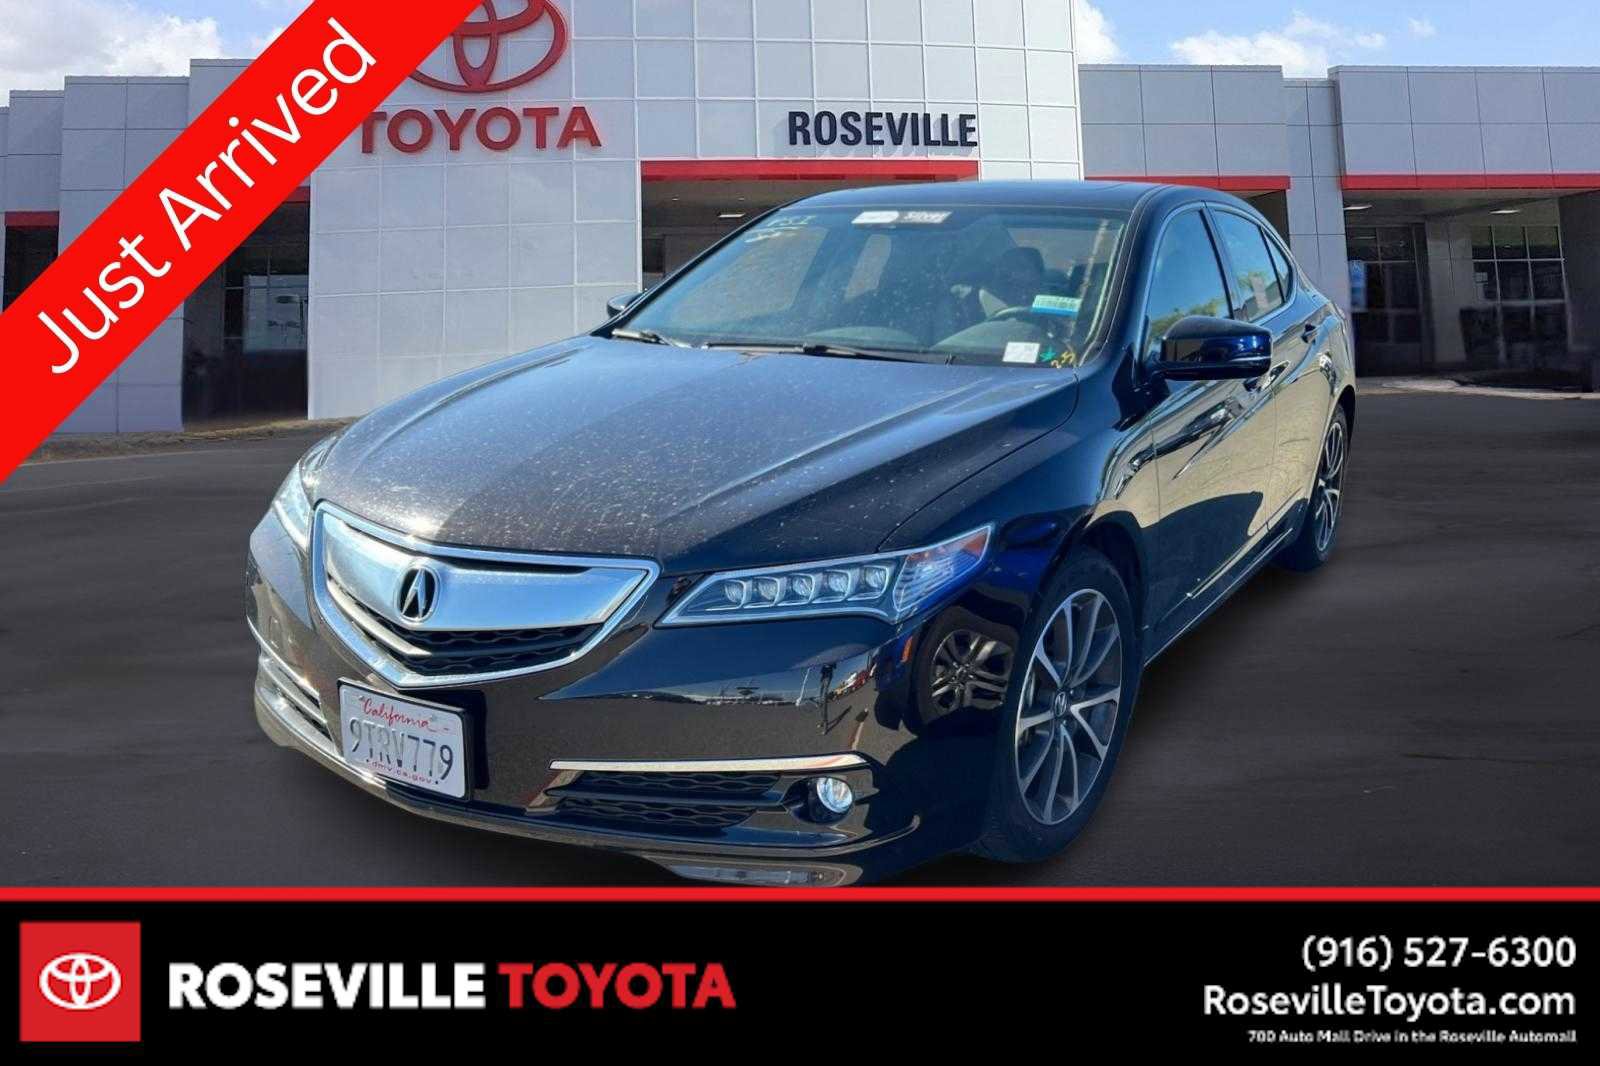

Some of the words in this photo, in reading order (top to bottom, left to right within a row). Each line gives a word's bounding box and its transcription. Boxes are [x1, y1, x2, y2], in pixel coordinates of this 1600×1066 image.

[360, 106, 602, 154] TOYOTA
[788, 111, 978, 147] ROSEVILLE
[361, 698, 431, 728] California
[350, 717, 453, 781] 9TRV779
[371, 760, 432, 784] dmv.ca.gov
